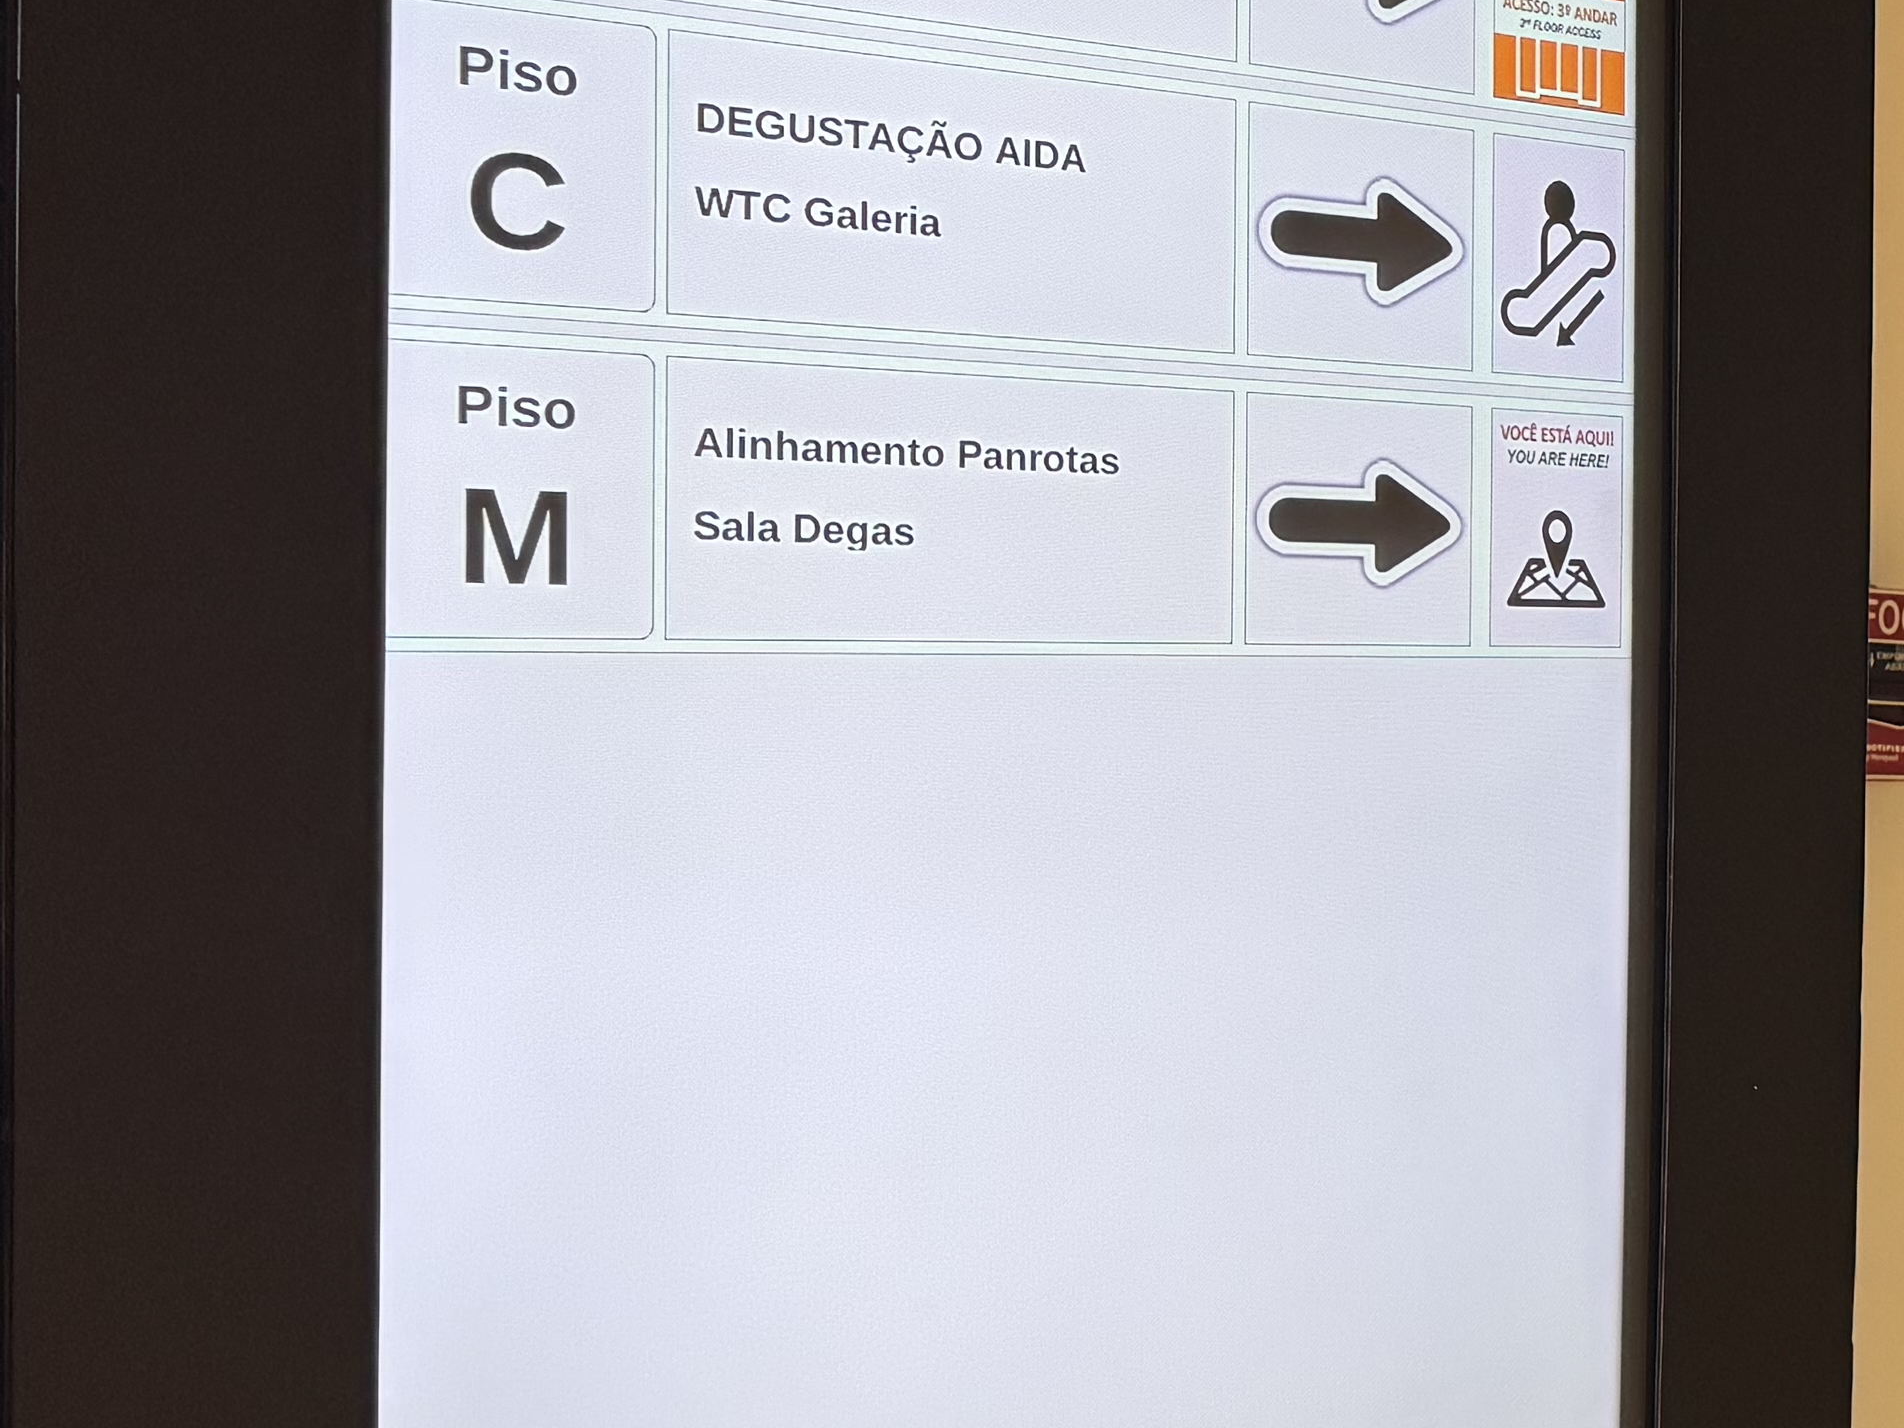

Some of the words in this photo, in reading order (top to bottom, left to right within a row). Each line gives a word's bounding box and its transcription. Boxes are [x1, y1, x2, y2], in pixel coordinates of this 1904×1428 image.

[1533, 20, 1564, 34] FLOOR
[1565, 25, 1602, 40] ACCESS
[1574, 7, 1617, 26] ANDAR
[459, 46, 578, 97] Piso
[697, 103, 983, 163] DEGUSTAÇÃO
[996, 137, 1086, 173] AIDA
[470, 152, 565, 251] C
[695, 186, 791, 223] WTC
[804, 197, 941, 238] Galeria
[457, 386, 576, 429] Piso
[694, 428, 945, 468] Alinhamento
[958, 439, 1120, 475] Panrotas
[1500, 423, 1537, 443] VOCÊ
[1541, 425, 1572, 444] ESTÁ
[1575, 429, 1614, 447] AQUI!
[1507, 449, 1536, 464] YOU
[1538, 451, 1567, 467] ARE
[1569, 453, 1610, 469] HERE!
[465, 489, 567, 585] M
[694, 510, 781, 543] Sala
[794, 513, 915, 551] Degas
